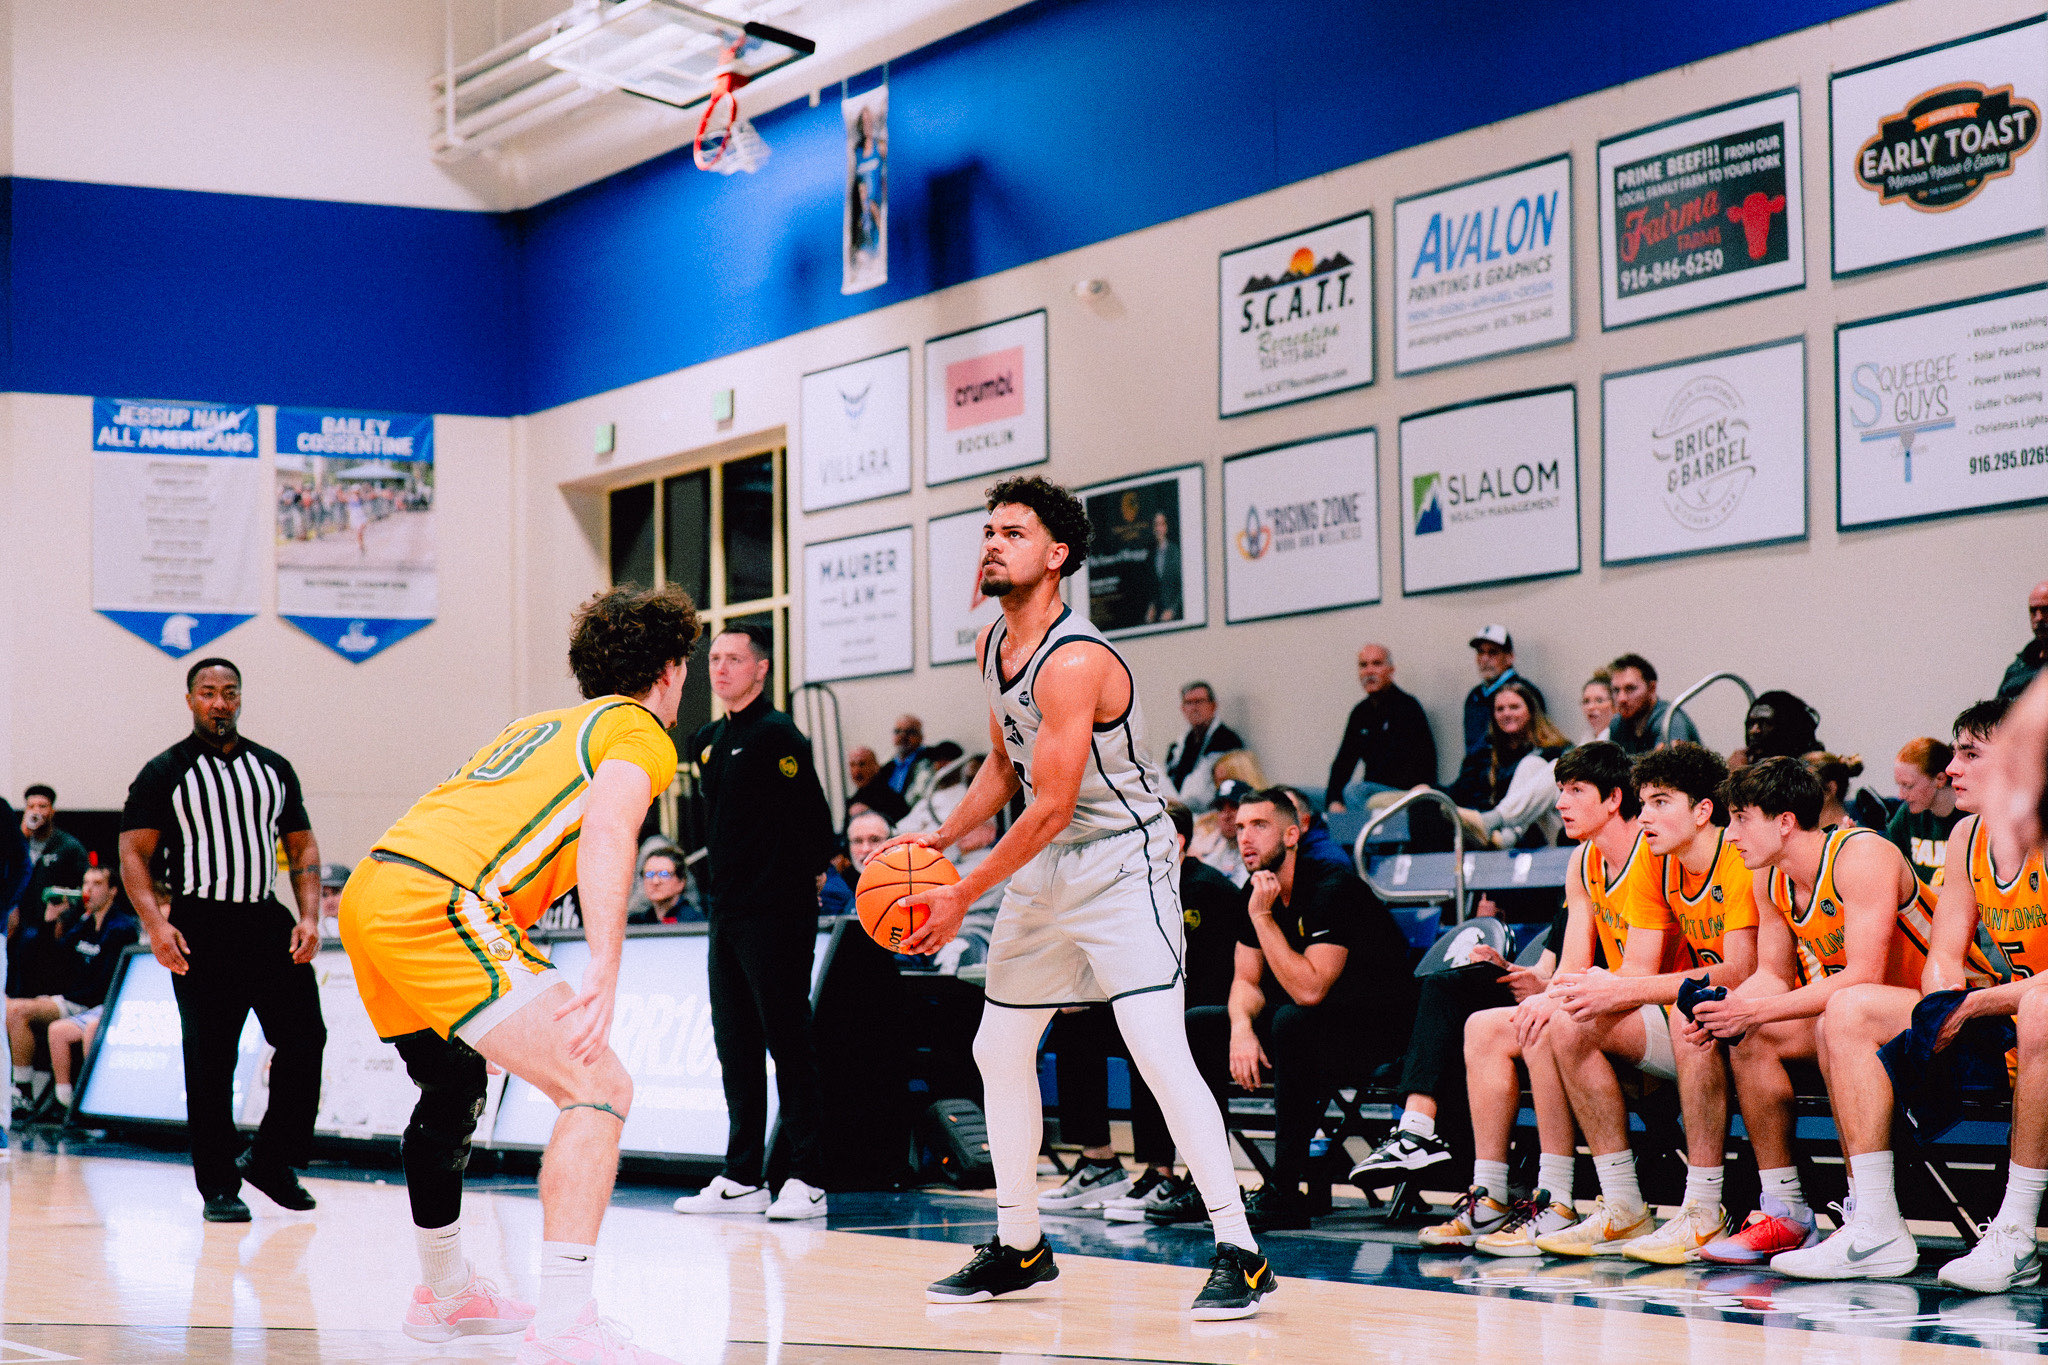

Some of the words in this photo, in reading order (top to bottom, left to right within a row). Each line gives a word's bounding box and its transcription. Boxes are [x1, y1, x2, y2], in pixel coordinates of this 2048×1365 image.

[1617, 161, 1662, 192] PRIME
[1666, 144, 1720, 177] BEEF!!!
[1724, 141, 1755, 161] FROM
[1756, 134, 1781, 155] OUR
[1863, 134, 1939, 179] EARLY
[1944, 110, 2031, 158] TOAST
[1617, 189, 1646, 208] LOCAL
[1646, 179, 1678, 199] FAMILY
[1679, 171, 1708, 190] FARM
[1708, 168, 1723, 185] TO
[1723, 161, 1752, 180] YOUR
[1752, 153, 1781, 173] FORK
[1929, 162, 1962, 181] House
[1411, 190, 1559, 279] AVALON
[1621, 190, 1719, 262] Fairma
[1678, 226, 1722, 253] FARMS
[1408, 275, 1470, 304] PRINTING
[1473, 272, 1482, 289] &
[1485, 254, 1553, 286] GRAPHICS
[1620, 248, 1724, 292] 916-846-6250
[1241, 272, 1354, 333] S.C.A.T.T.
[1973, 323, 2007, 337] Window
[2010, 315, 2048, 330] Washing
[1973, 350, 1995, 363] Solar
[1998, 343, 2023, 356] Panel
[955, 368, 1014, 407] crumbl
[1851, 353, 1958, 428] SQUEEGEE
[1973, 374, 2000, 387] Power
[2003, 366, 2041, 380] Washing
[113, 405, 191, 428] JESSUP
[1895, 384, 1949, 424] GUYS
[1974, 399, 2001, 411] Gutter
[2003, 391, 2042, 406] Cleaning
[97, 426, 136, 448] ALL
[138, 429, 254, 454] AMERICANS
[321, 416, 391, 437] BAILEY
[956, 429, 1015, 456] ROCKLIN
[1675, 417, 1729, 462] BRICK
[1974, 420, 2018, 435] Christmas
[819, 446, 892, 486] VILLARA
[1448, 459, 1560, 506] SLALOM
[1274, 502, 1319, 536] RISING
[1322, 492, 1360, 528] ZONE
[1488, 496, 1560, 516] MANAGEMENT
[818, 547, 898, 585] MAURER
[841, 584, 877, 609] LAW
